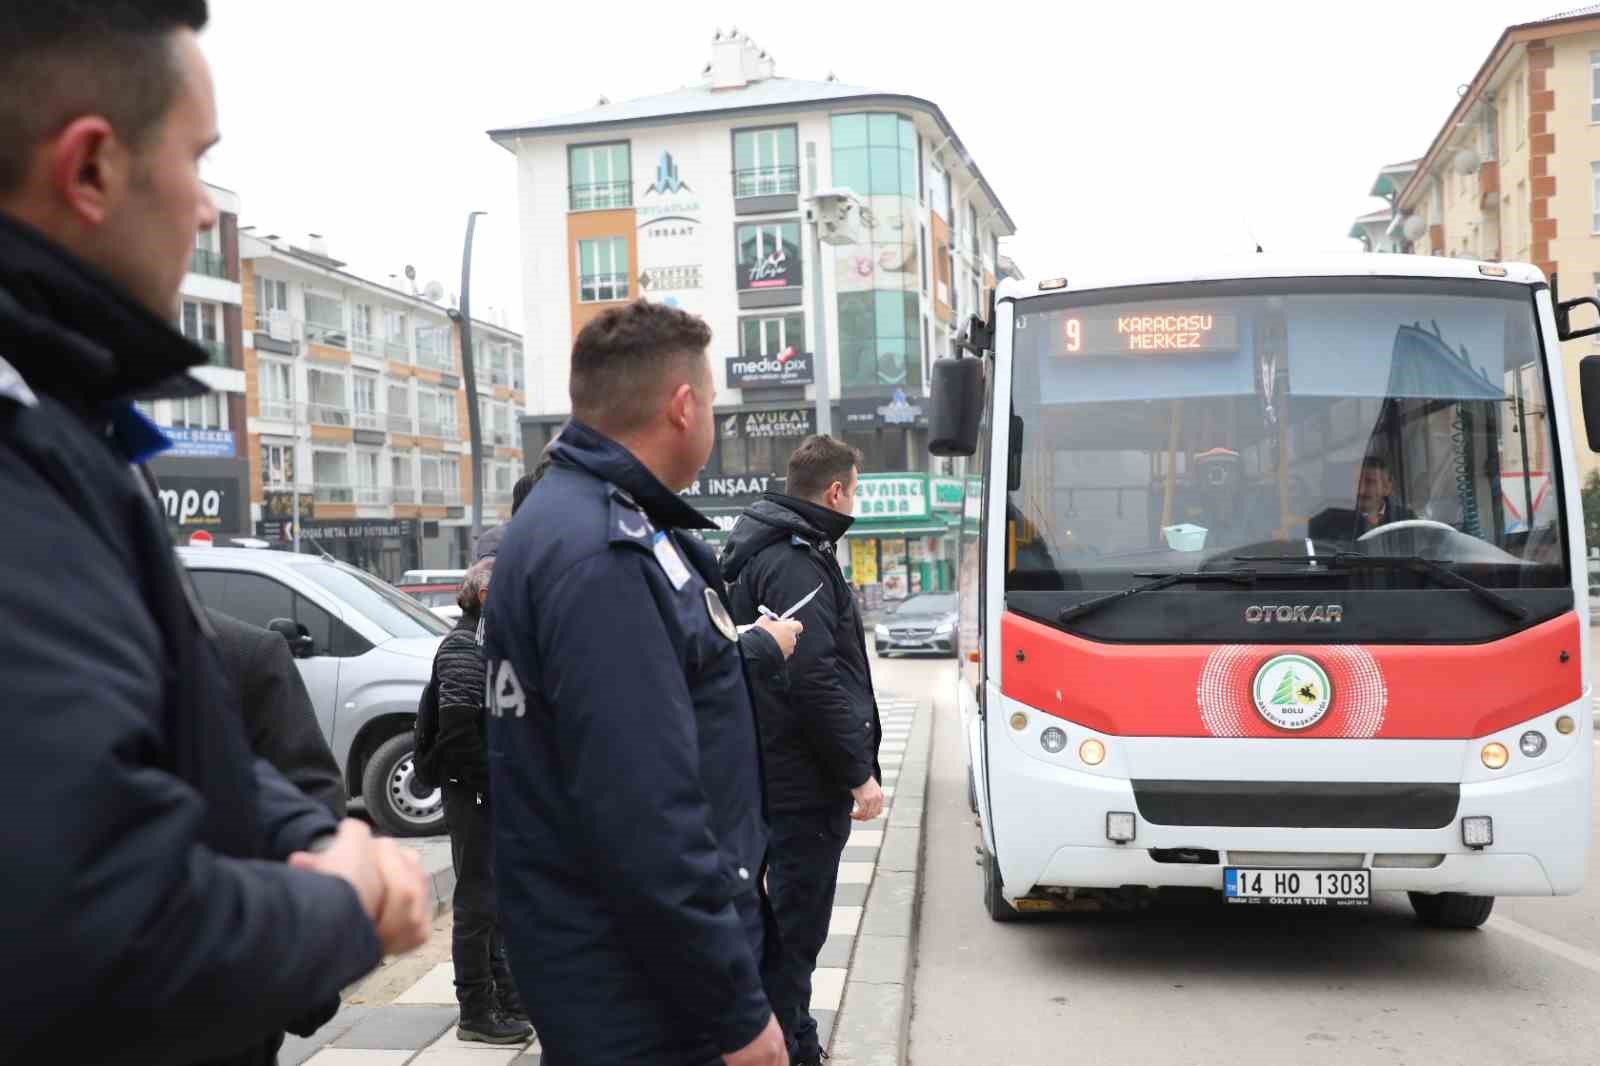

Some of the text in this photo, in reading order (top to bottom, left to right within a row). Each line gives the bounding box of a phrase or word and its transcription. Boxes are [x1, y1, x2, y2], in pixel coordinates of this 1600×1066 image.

[1117, 314, 1213, 333] KARACASU
[1066, 319, 1081, 351] 9
[1129, 332, 1201, 350] MERKEZ
[745, 410, 809, 425] AVUKAT
[708, 477, 769, 497] İNŞAAT
[1244, 604, 1344, 623] OTOKAR
[1281, 706, 1305, 714] BOLU
[1240, 872, 1263, 894] 14
[1315, 873, 1366, 895] 1303
[1269, 896, 1303, 905] OKAN
[1304, 897, 1328, 905] TUR
